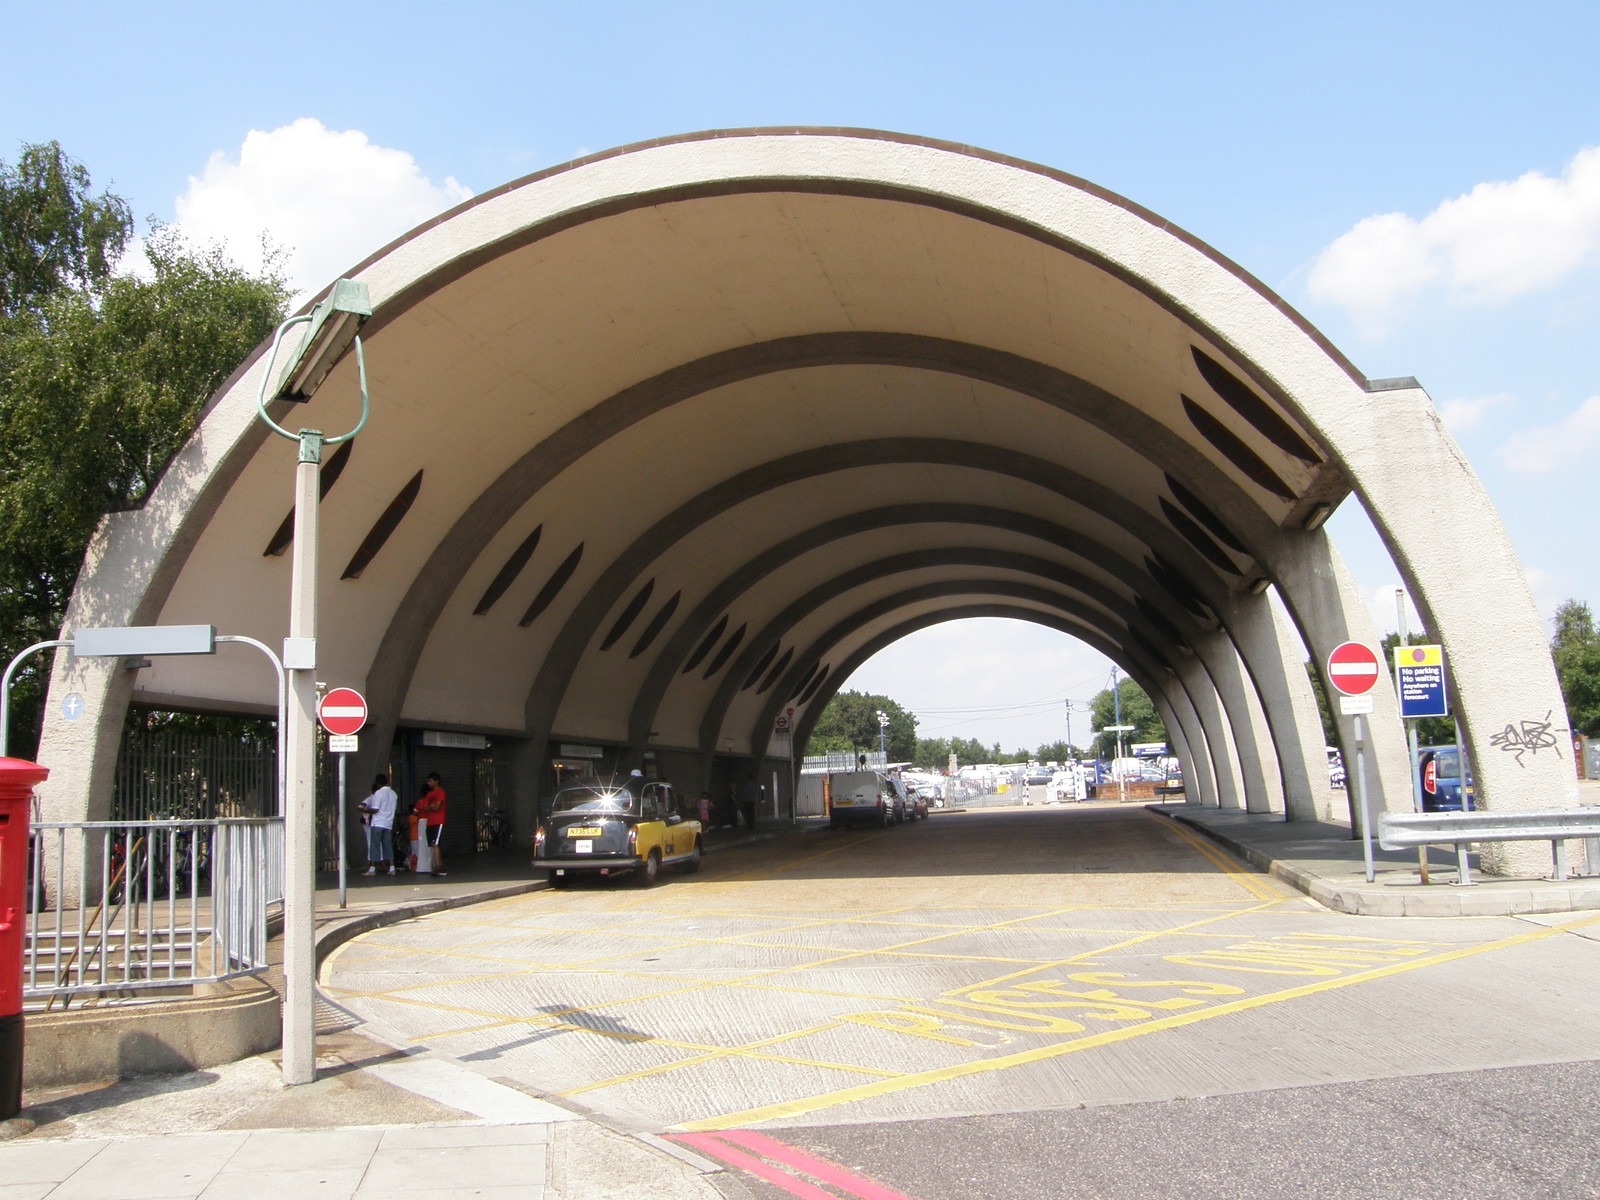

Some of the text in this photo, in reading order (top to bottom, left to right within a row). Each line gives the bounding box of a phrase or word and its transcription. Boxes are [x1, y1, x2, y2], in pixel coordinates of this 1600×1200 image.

[1414, 667, 1439, 676] parking
[1415, 675, 1440, 683] waiting
[832, 932, 1457, 1048] BUSES ONLY
